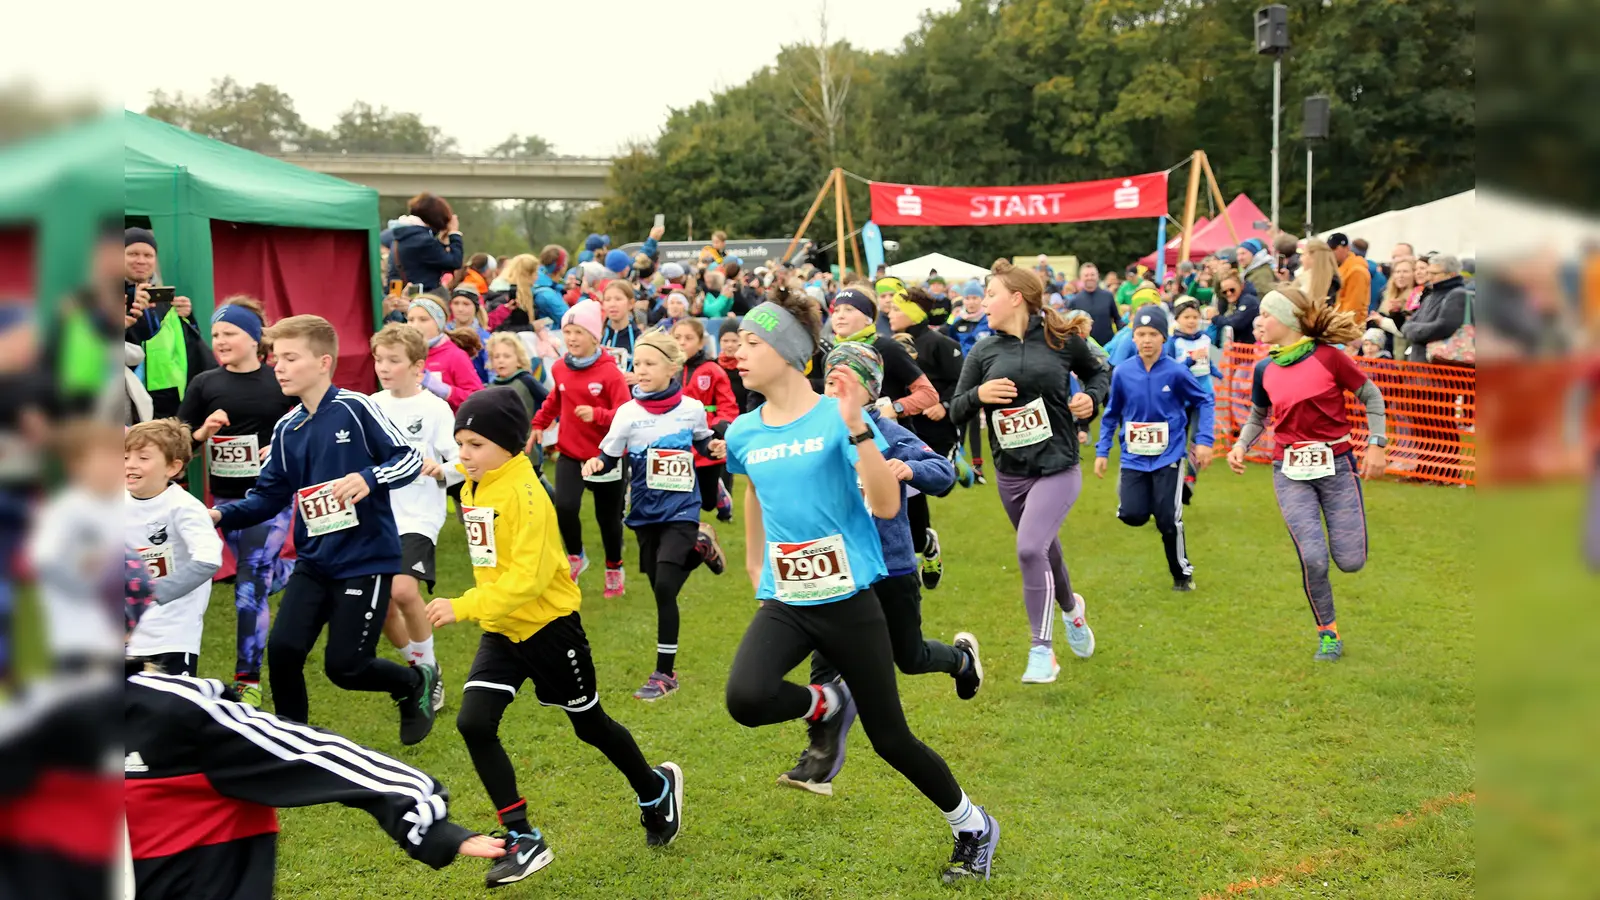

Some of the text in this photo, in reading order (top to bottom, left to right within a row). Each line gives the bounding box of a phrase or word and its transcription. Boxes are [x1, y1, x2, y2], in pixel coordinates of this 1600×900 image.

[970, 192, 1066, 218] START
[1004, 413, 1038, 434] 320
[1132, 431, 1158, 444] 291
[214, 446, 247, 463] 259
[1293, 451, 1323, 466] 283
[657, 460, 690, 476] 302
[304, 494, 341, 519] 318
[802, 544, 834, 555] Reiter
[781, 554, 833, 580] 290
[345, 588, 363, 596] JAKO
[567, 695, 588, 706] JAKO
